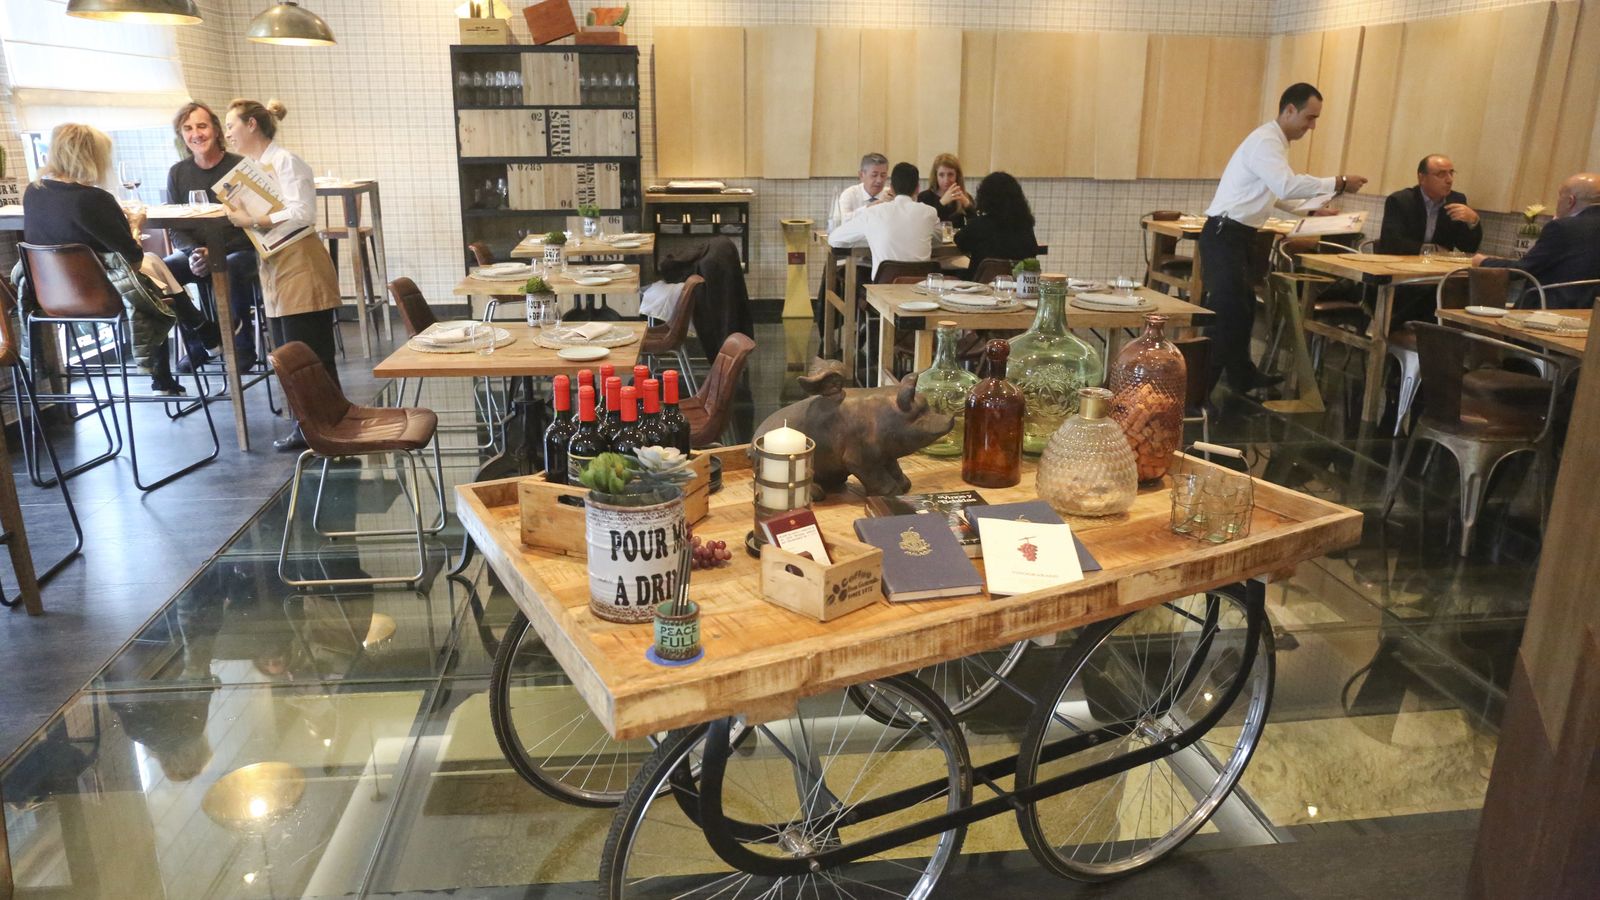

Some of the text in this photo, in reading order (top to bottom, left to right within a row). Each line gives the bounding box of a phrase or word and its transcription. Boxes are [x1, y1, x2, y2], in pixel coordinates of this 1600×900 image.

[563, 53, 575, 62] 01
[531, 112, 543, 121] 02
[622, 111, 635, 120] 03
[551, 111, 561, 155] INDUS
[560, 110, 571, 155] TRIEL
[606, 163, 619, 172] 05
[561, 200, 573, 208] 04
[608, 216, 620, 224] 06
[609, 530, 669, 562] POUR
[614, 575, 630, 606] A
[660, 624, 697, 637] PEACE
[660, 635, 697, 648] FULL
